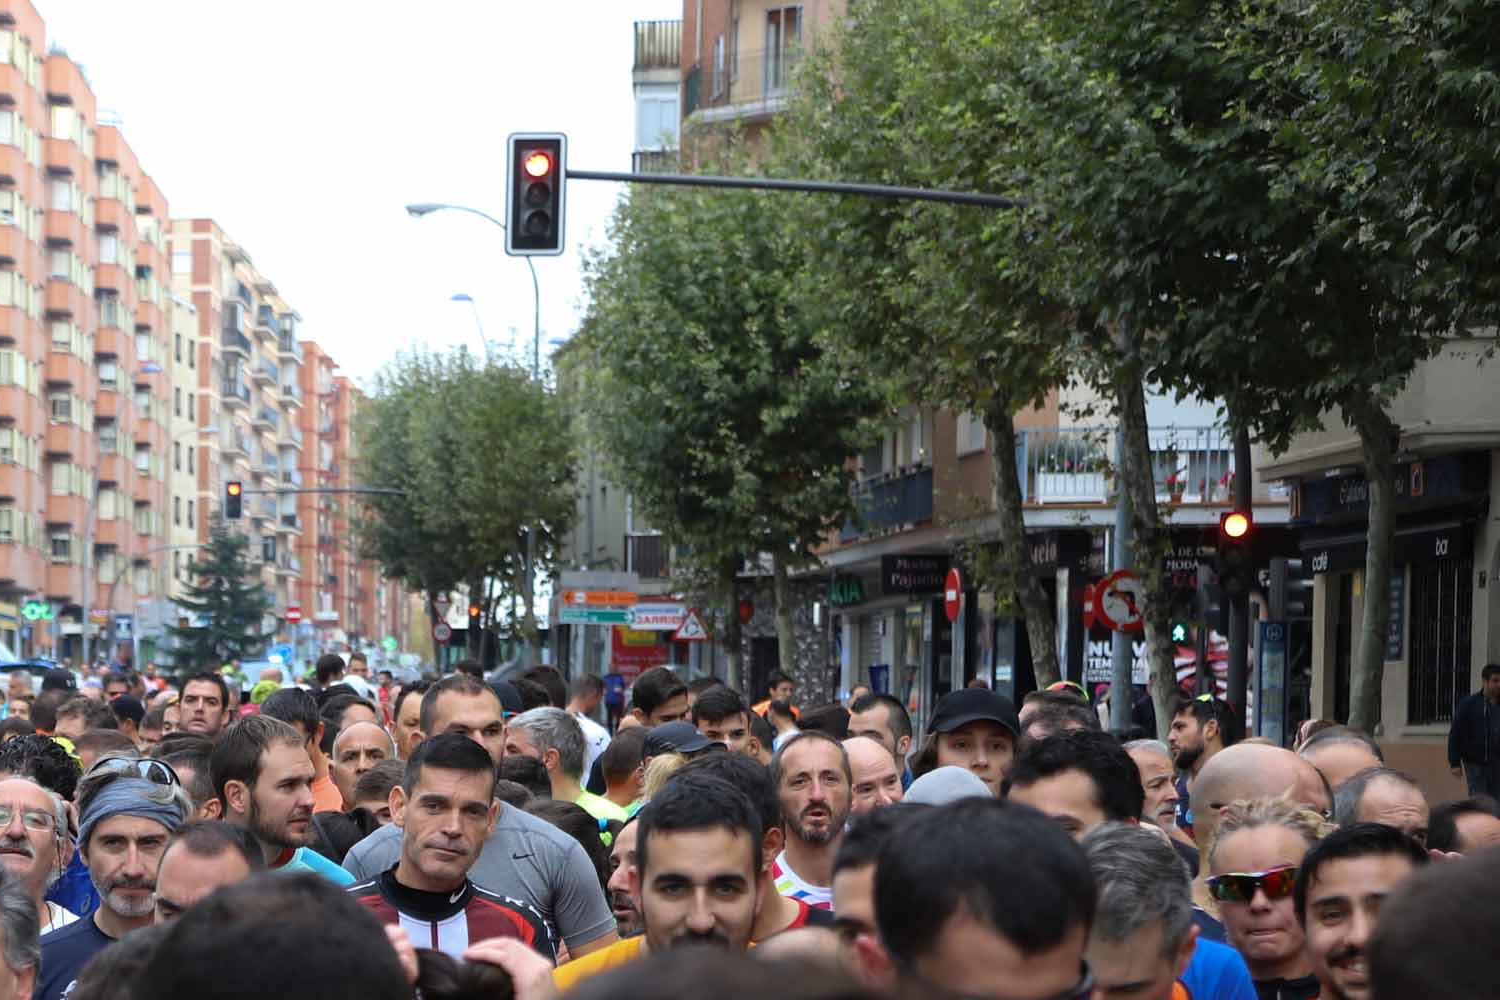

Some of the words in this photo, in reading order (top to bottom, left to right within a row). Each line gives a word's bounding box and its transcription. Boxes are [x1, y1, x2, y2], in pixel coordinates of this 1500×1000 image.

[1166, 560, 1199, 570] MODA
[1312, 552, 1328, 572] café
[1435, 536, 1449, 556] bar
